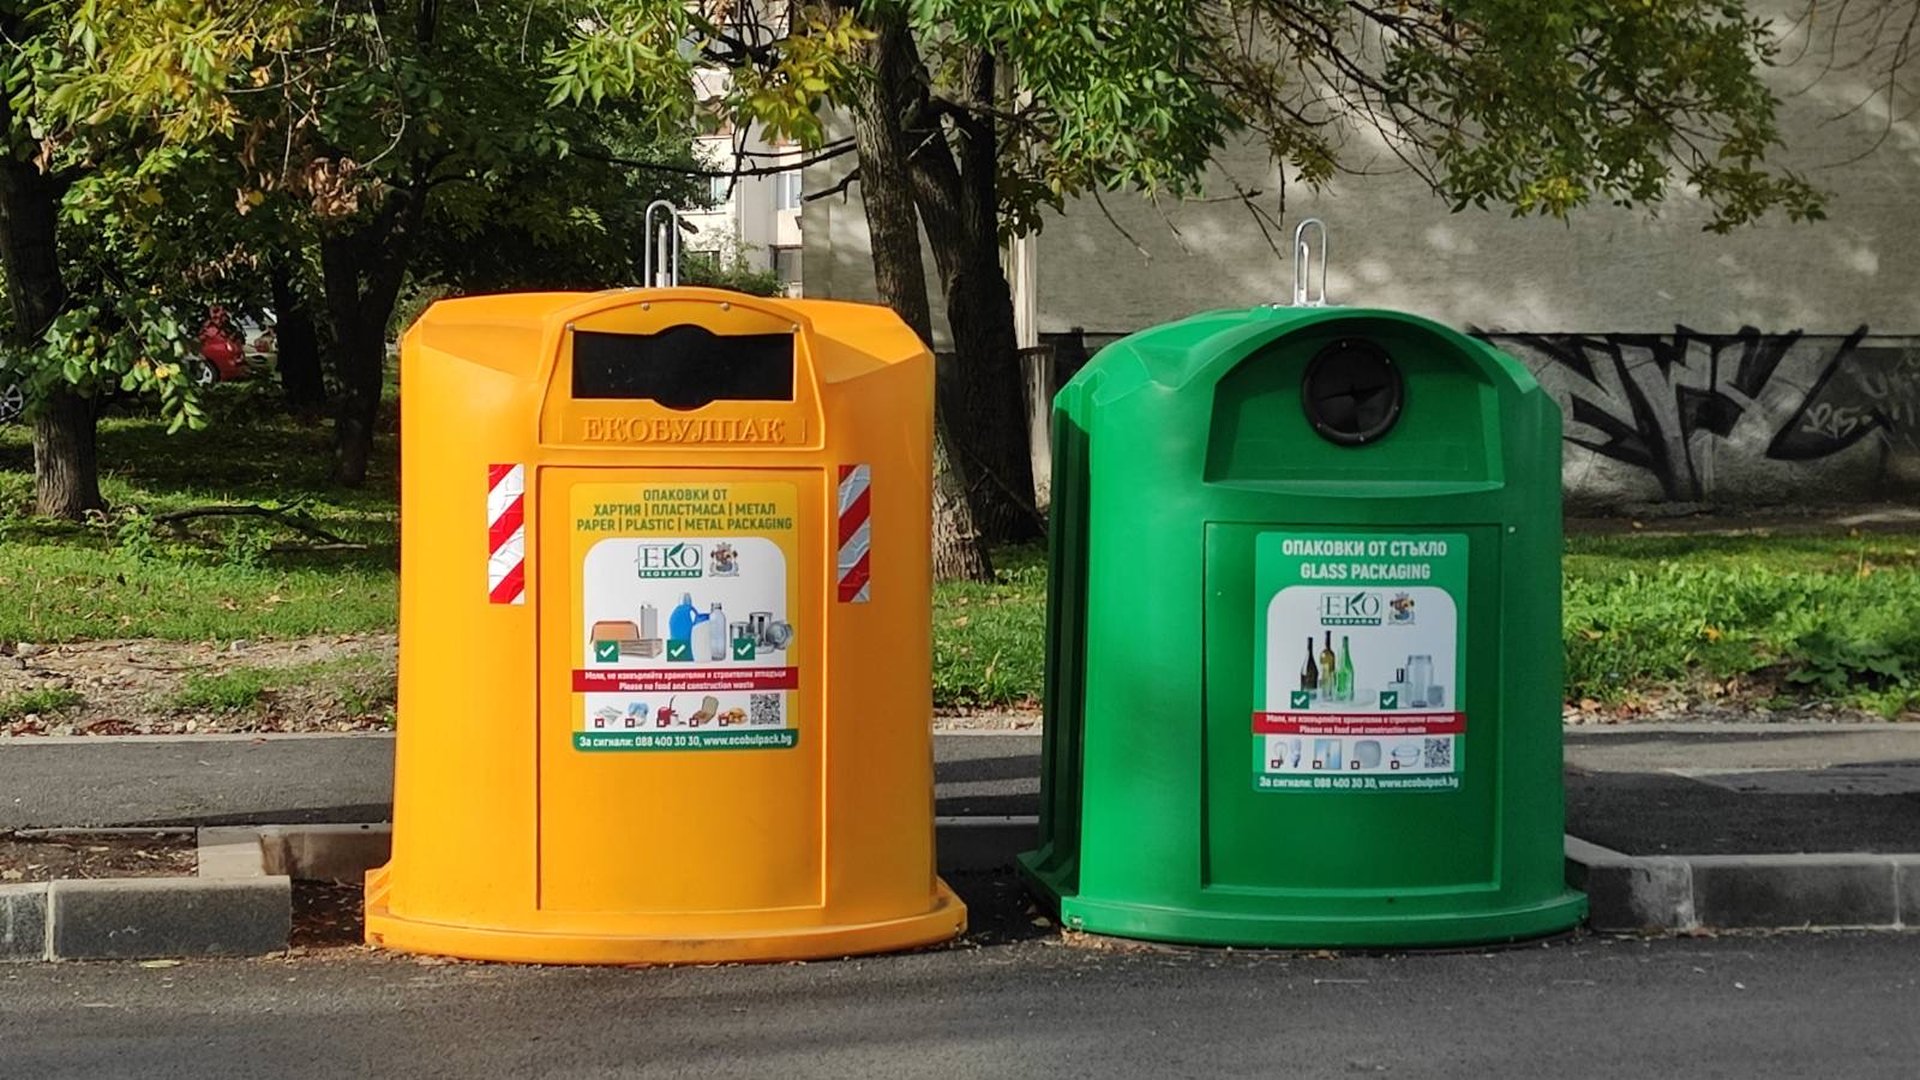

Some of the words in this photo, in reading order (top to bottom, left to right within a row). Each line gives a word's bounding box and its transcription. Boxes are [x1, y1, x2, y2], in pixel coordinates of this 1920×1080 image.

[583, 417, 785, 443] ЕКОБУЛПАК
[643, 489, 709, 501] ОПАКОВКИ
[712, 489, 728, 501] ОТ
[594, 504, 641, 516] ХАРТИЯ
[651, 504, 725, 515] ПЛАСТМАСА
[735, 503, 776, 515] МЕТАЛ
[577, 519, 615, 531] PAPER
[626, 519, 674, 531] PLASTIC
[685, 518, 723, 530] METAL
[727, 518, 792, 530] PACKAGING
[1282, 539, 1364, 556] ОПАКОВКИ
[1368, 541, 1387, 556] ОТ
[1390, 541, 1447, 557] СТЪКЛО
[1301, 563, 1347, 579] GLASS
[1351, 563, 1431, 580] PACKAGING
[619, 682, 643, 690] Please
[654, 682, 671, 690] food
[672, 682, 686, 690] and
[579, 737, 591, 747] За
[635, 737, 653, 746] 088
[654, 737, 673, 746] 400
[674, 737, 686, 746] 30
[687, 736, 702, 747] 30,
[703, 734, 792, 746] www.ecobulpack.bg
[1332, 777, 1350, 788] 400
